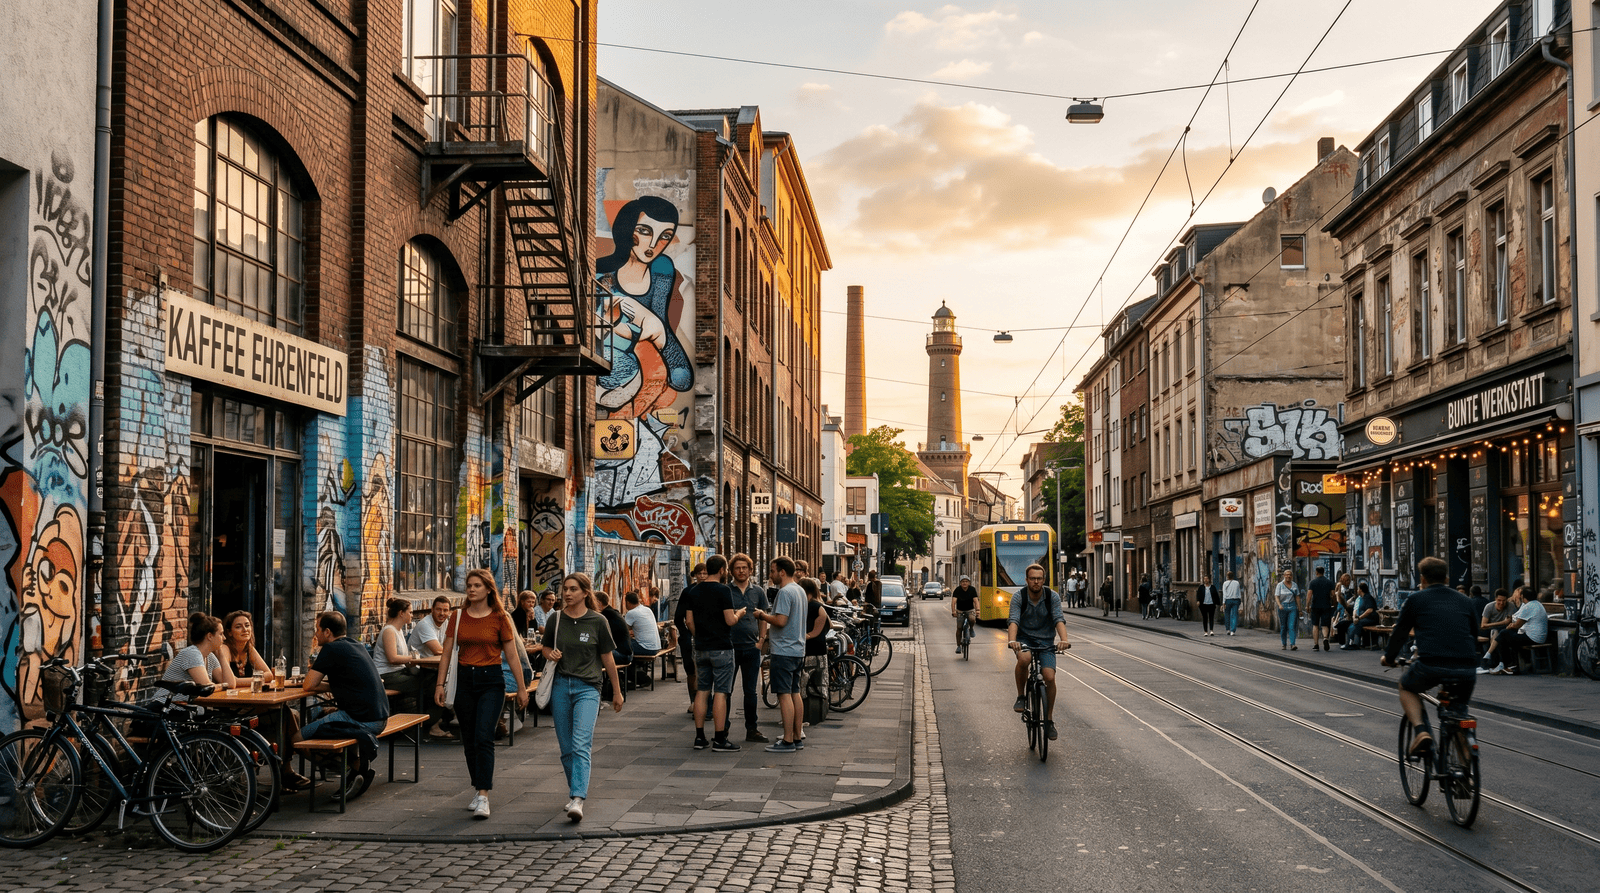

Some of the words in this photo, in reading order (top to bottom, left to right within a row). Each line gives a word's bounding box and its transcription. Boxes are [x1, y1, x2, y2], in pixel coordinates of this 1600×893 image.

[168, 304, 246, 378] KAFFEE
[251, 332, 343, 404] EHRENFELD
[1448, 394, 1479, 430] BUNTE
[1481, 372, 1545, 420] WERKSTATT
